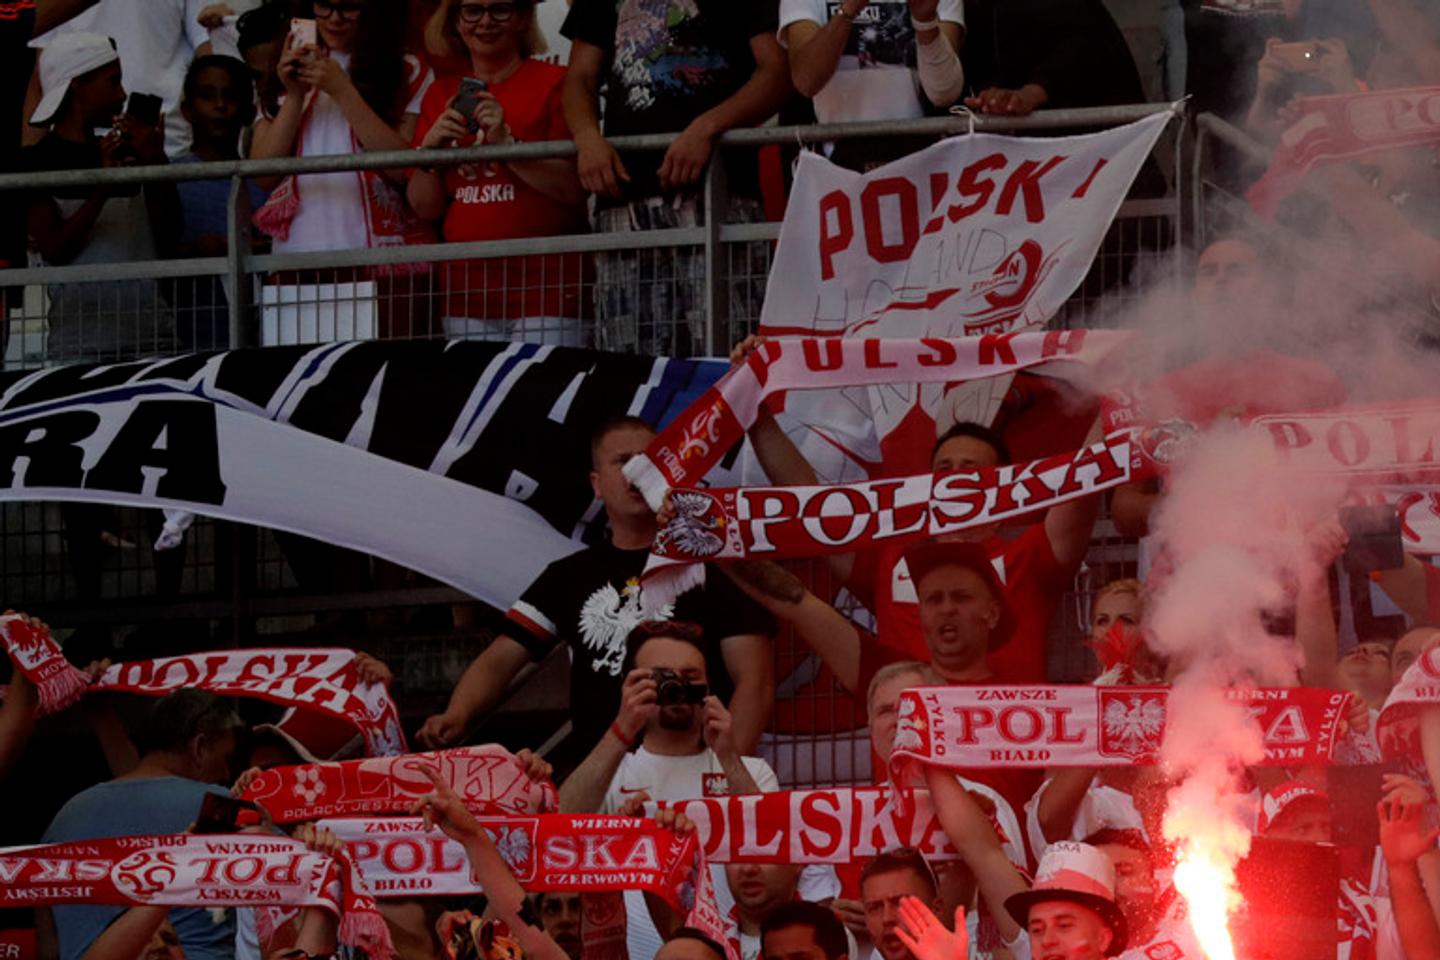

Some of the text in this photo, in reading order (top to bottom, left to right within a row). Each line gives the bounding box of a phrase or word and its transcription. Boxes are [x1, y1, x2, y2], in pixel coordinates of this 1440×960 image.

[455, 184, 515, 205] POLSKA
[742, 440, 1128, 554] POLSKA
[976, 688, 1058, 701] ZAWSZE
[926, 693, 946, 757] TYLKO
[952, 704, 1087, 745] POL
[1315, 692, 1342, 756] TYLKO
[989, 748, 1051, 763] BIAŁO
[363, 821, 424, 834] ZAWSZ
[568, 817, 642, 830] WIERNI
[351, 839, 466, 876] POL
[542, 834, 663, 871] SKA
[190, 855, 304, 884] POL
[373, 872, 656, 891] BIAŁO CZERWONYM
